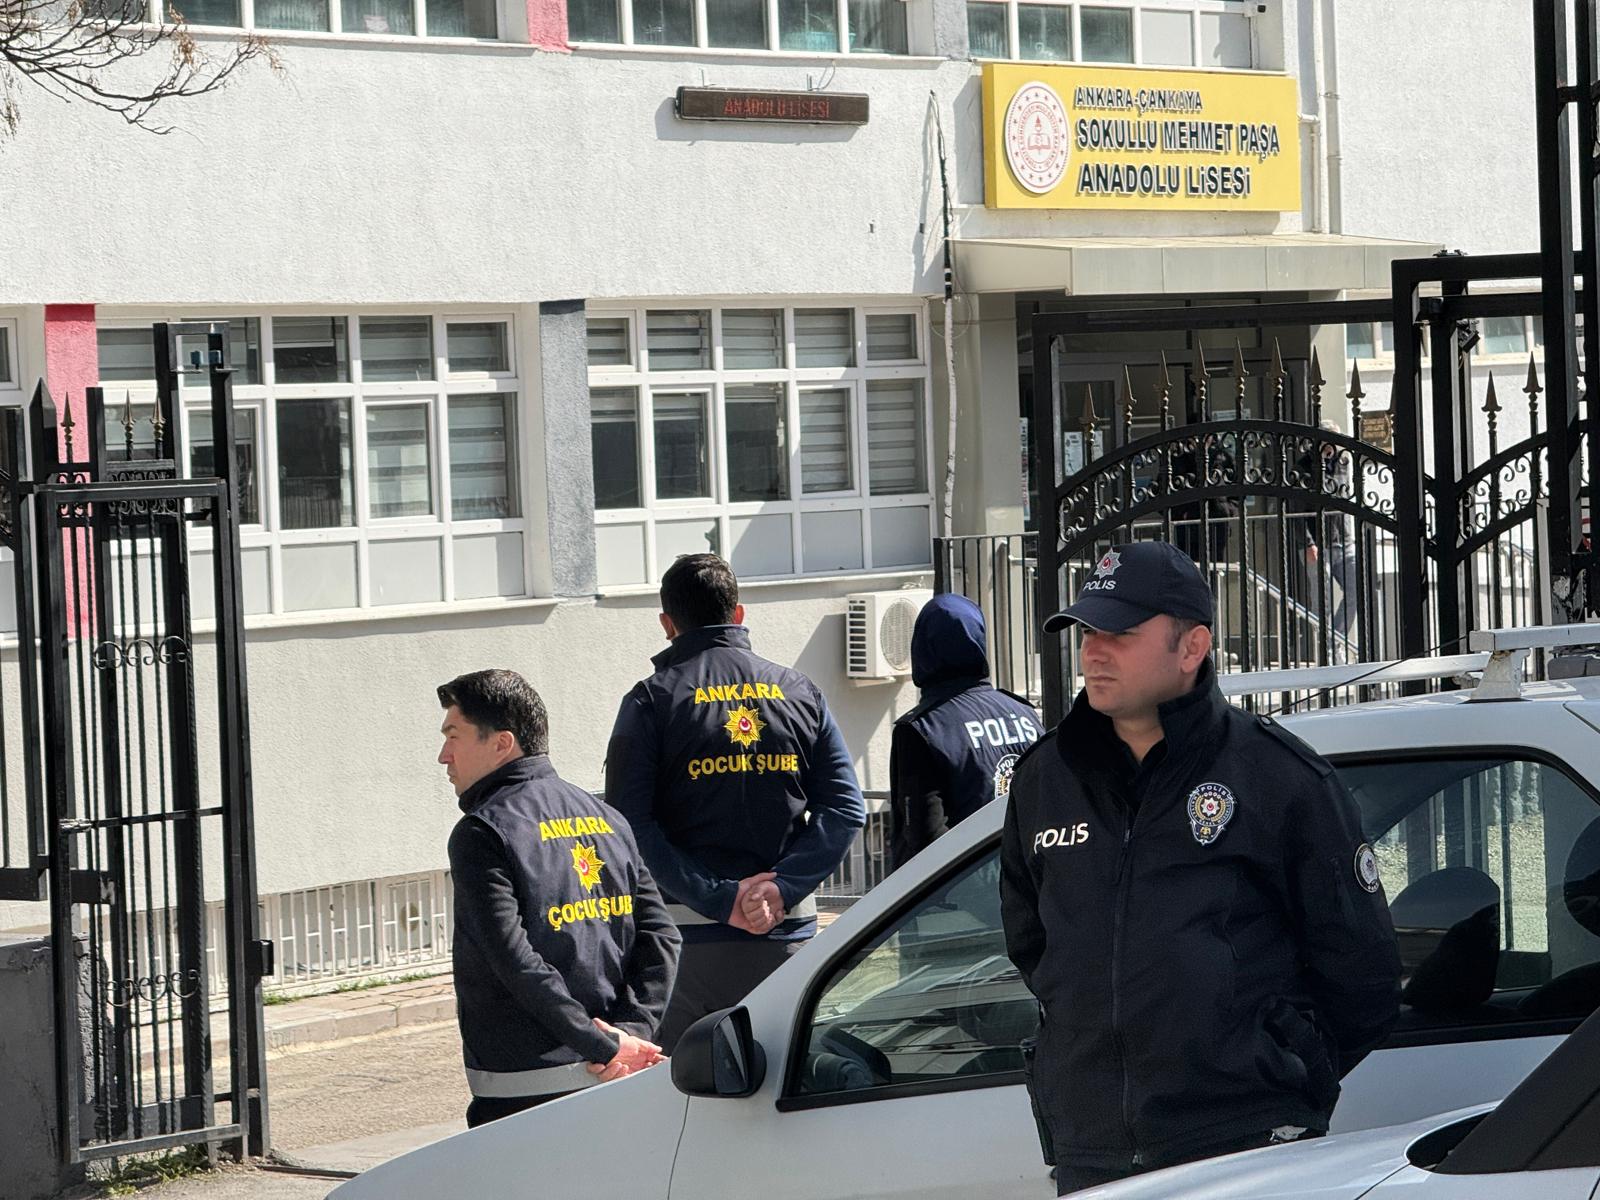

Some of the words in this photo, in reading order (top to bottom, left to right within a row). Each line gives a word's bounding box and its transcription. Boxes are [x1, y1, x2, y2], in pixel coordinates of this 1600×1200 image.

[724, 97, 785, 116] ANADOLU
[1078, 118, 1158, 149] SOKULLU
[1163, 121, 1234, 151] MEHMET
[1239, 124, 1280, 160] PAŞA
[1080, 163, 1180, 193] ANADOLU
[694, 682, 786, 705] ANKARA
[688, 754, 753, 780] ÇOCUK
[756, 753, 800, 775] ŞUBE
[539, 816, 615, 842] ANKARA
[598, 894, 633, 922] ŞUB
